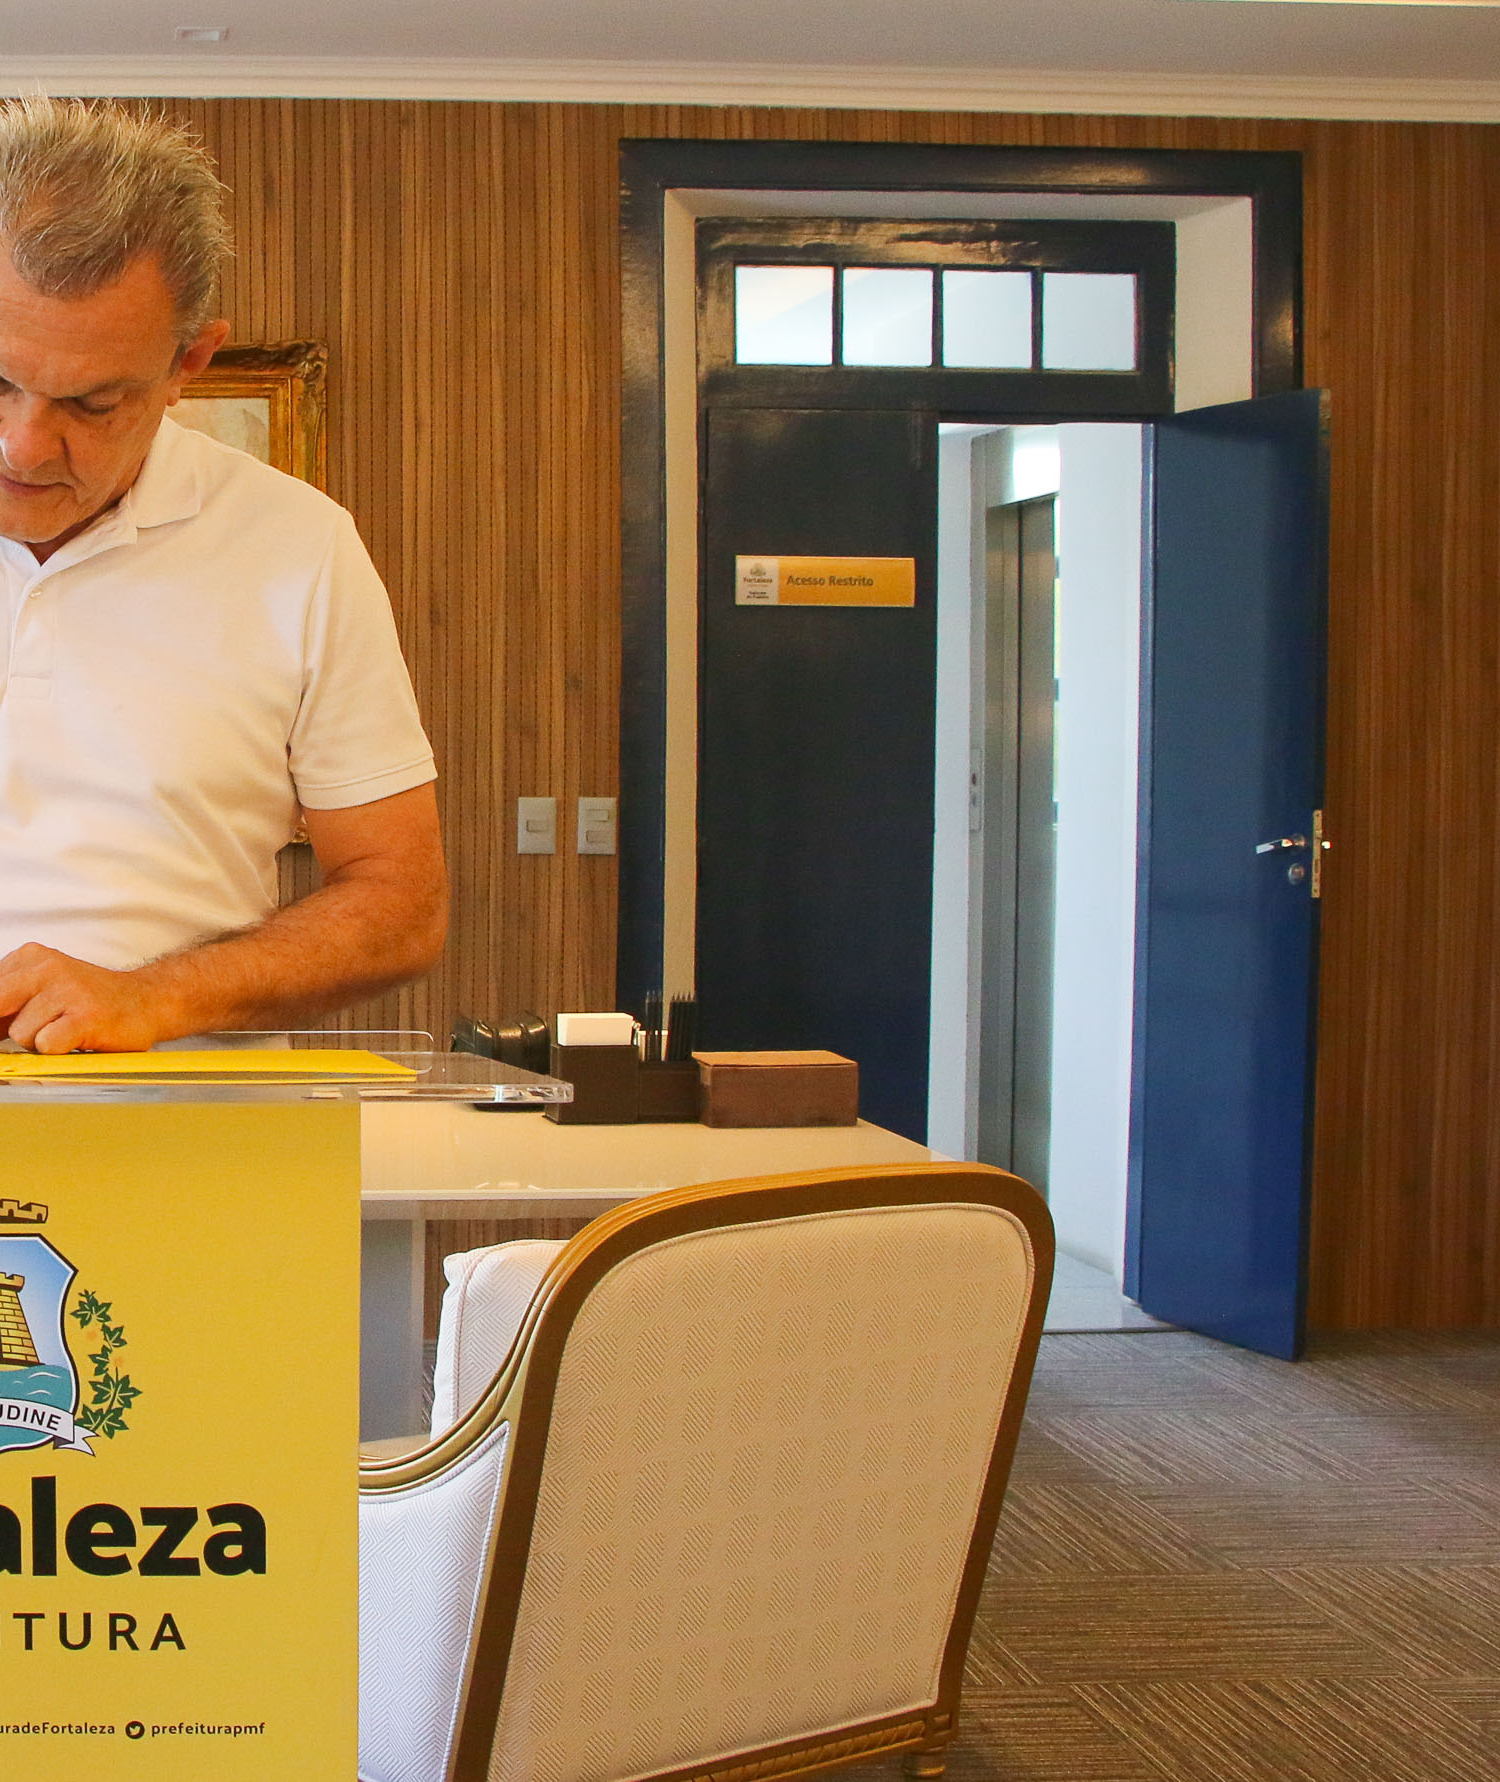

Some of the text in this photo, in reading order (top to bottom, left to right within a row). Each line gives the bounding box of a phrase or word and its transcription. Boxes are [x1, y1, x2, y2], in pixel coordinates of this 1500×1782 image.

[786, 575, 874, 587] Acesso Restrito
[151, 1721, 266, 1738] prefeiturapmf
